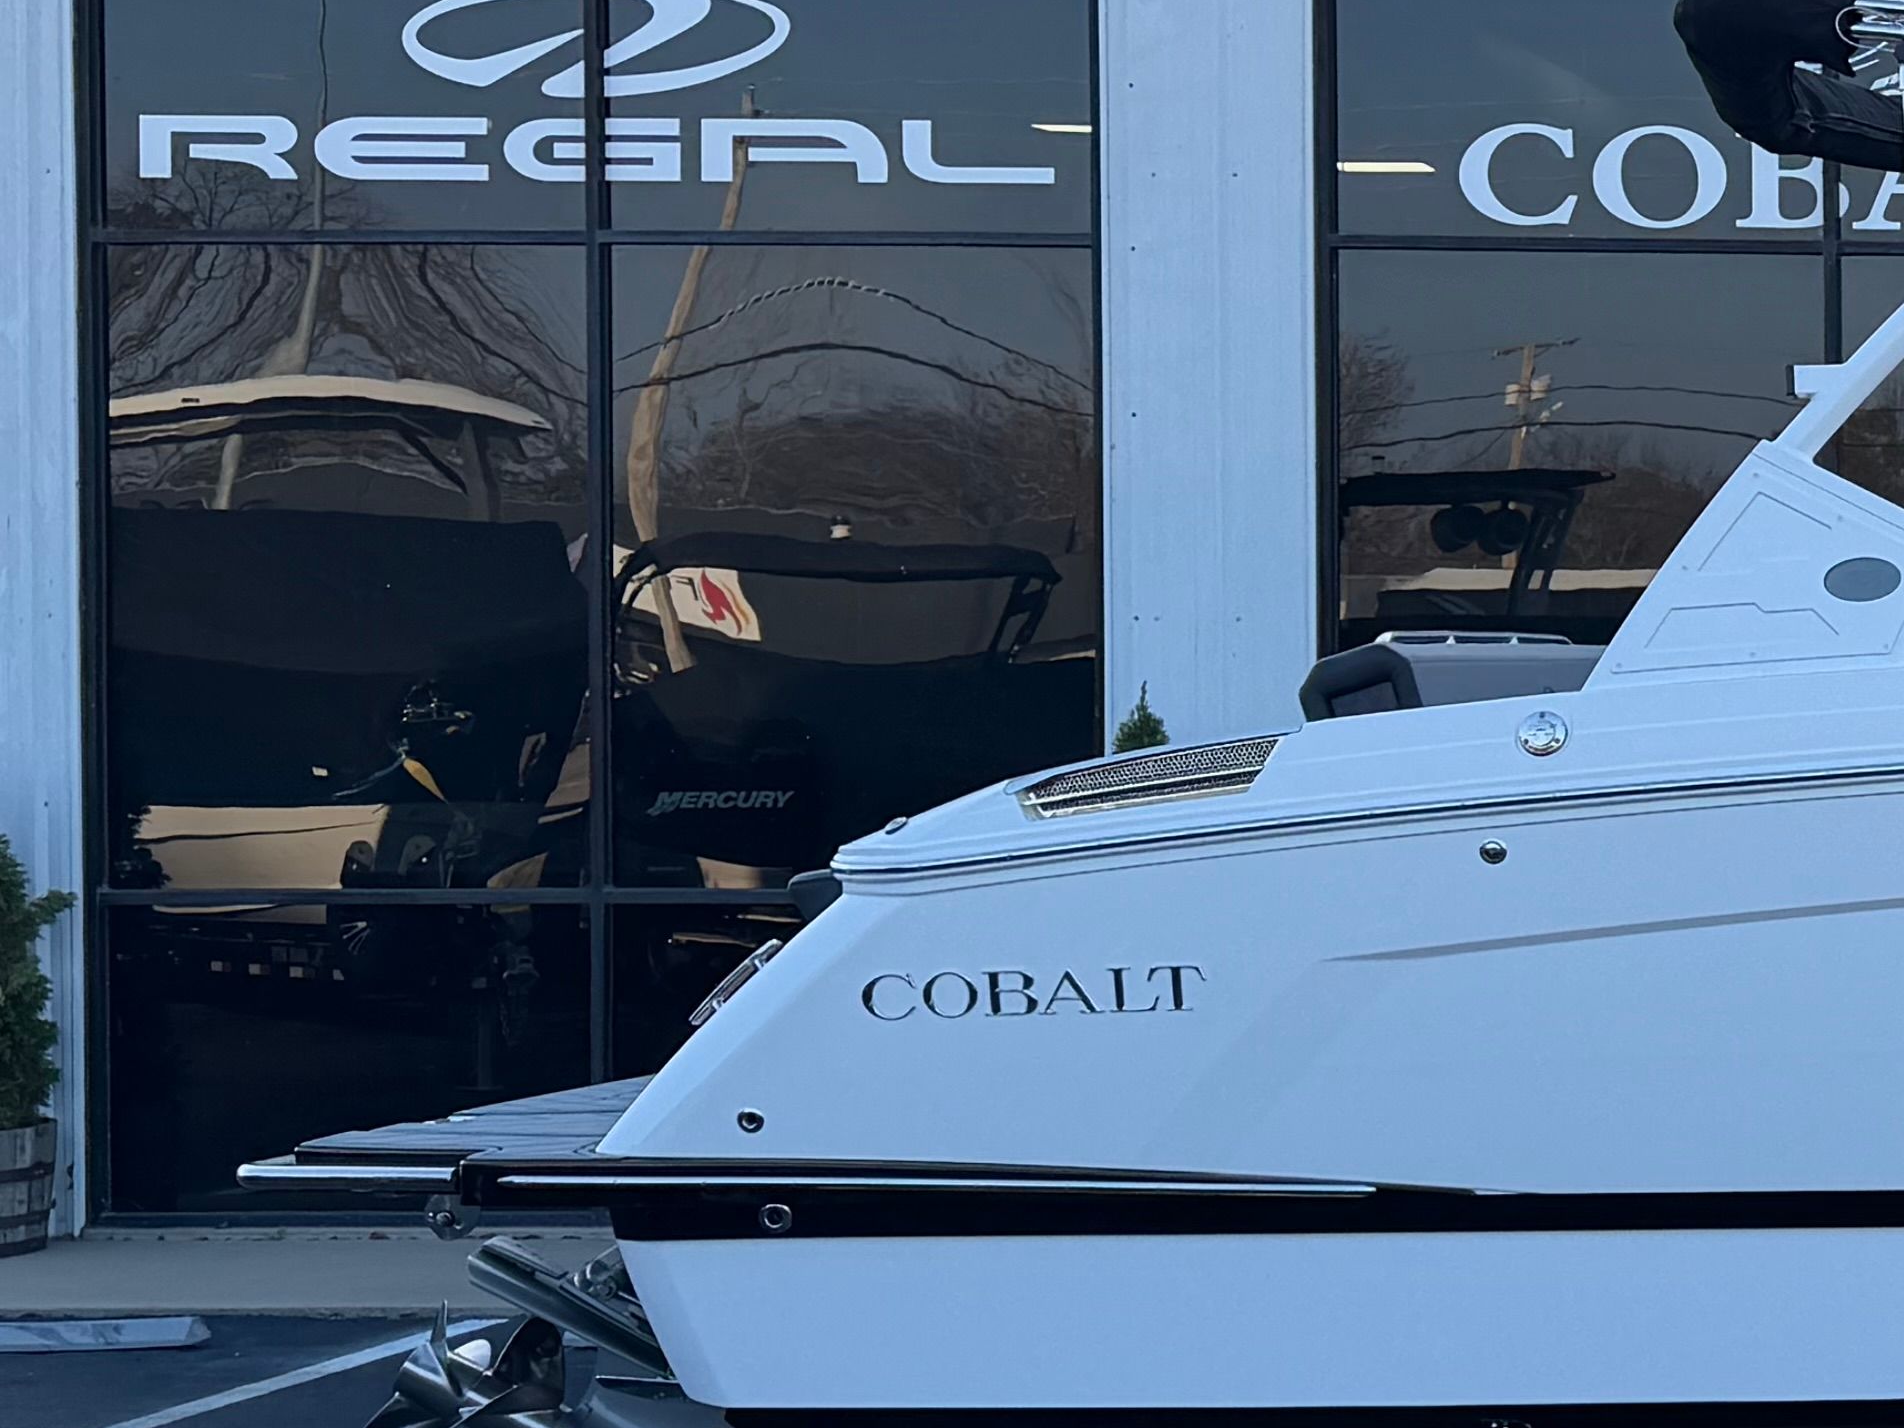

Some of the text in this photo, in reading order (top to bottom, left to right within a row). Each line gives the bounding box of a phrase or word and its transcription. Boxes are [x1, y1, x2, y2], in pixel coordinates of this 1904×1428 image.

[137, 114, 1058, 187] REGAL
[646, 791, 794, 816] MERCURY
[862, 965, 1207, 1021] COBALT
